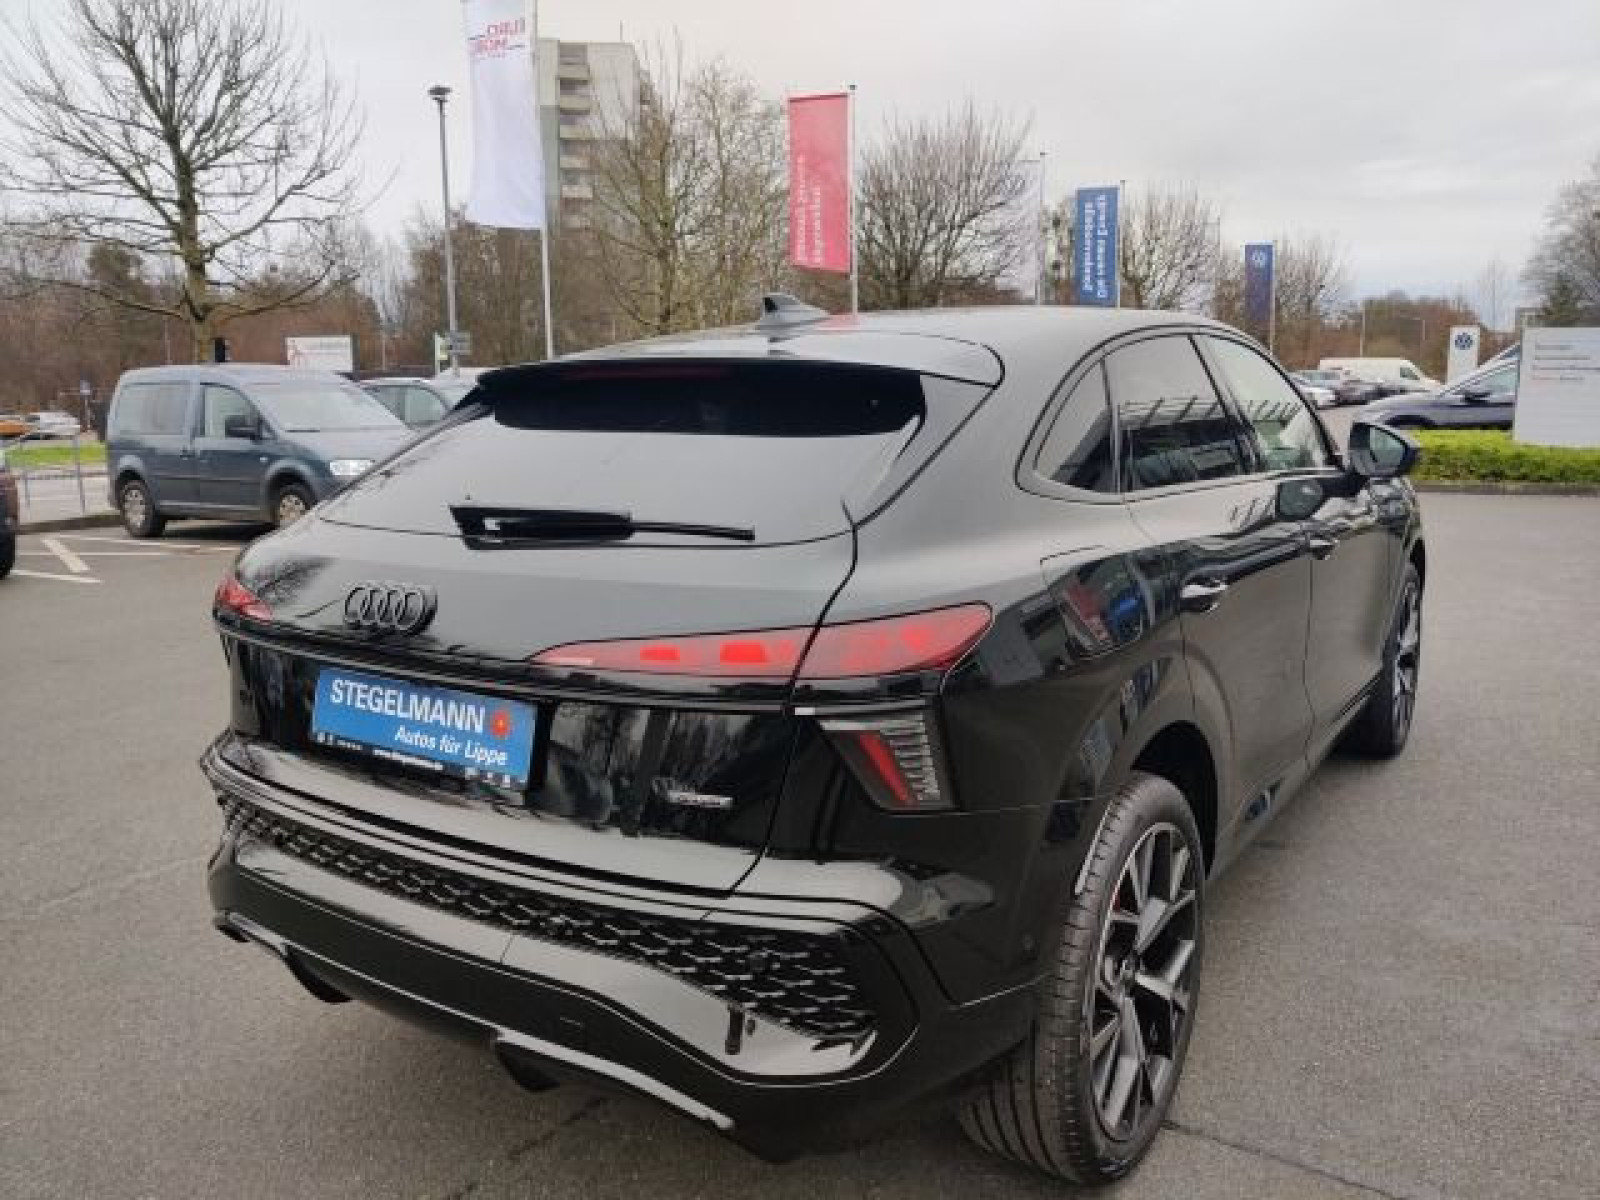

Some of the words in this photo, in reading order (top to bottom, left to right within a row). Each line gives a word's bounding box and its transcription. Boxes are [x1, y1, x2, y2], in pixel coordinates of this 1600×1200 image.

[330, 678, 485, 733] STEGELMANN
[394, 725, 436, 751] Autos
[440, 734, 461, 755] für
[464, 739, 508, 766] Lippe
